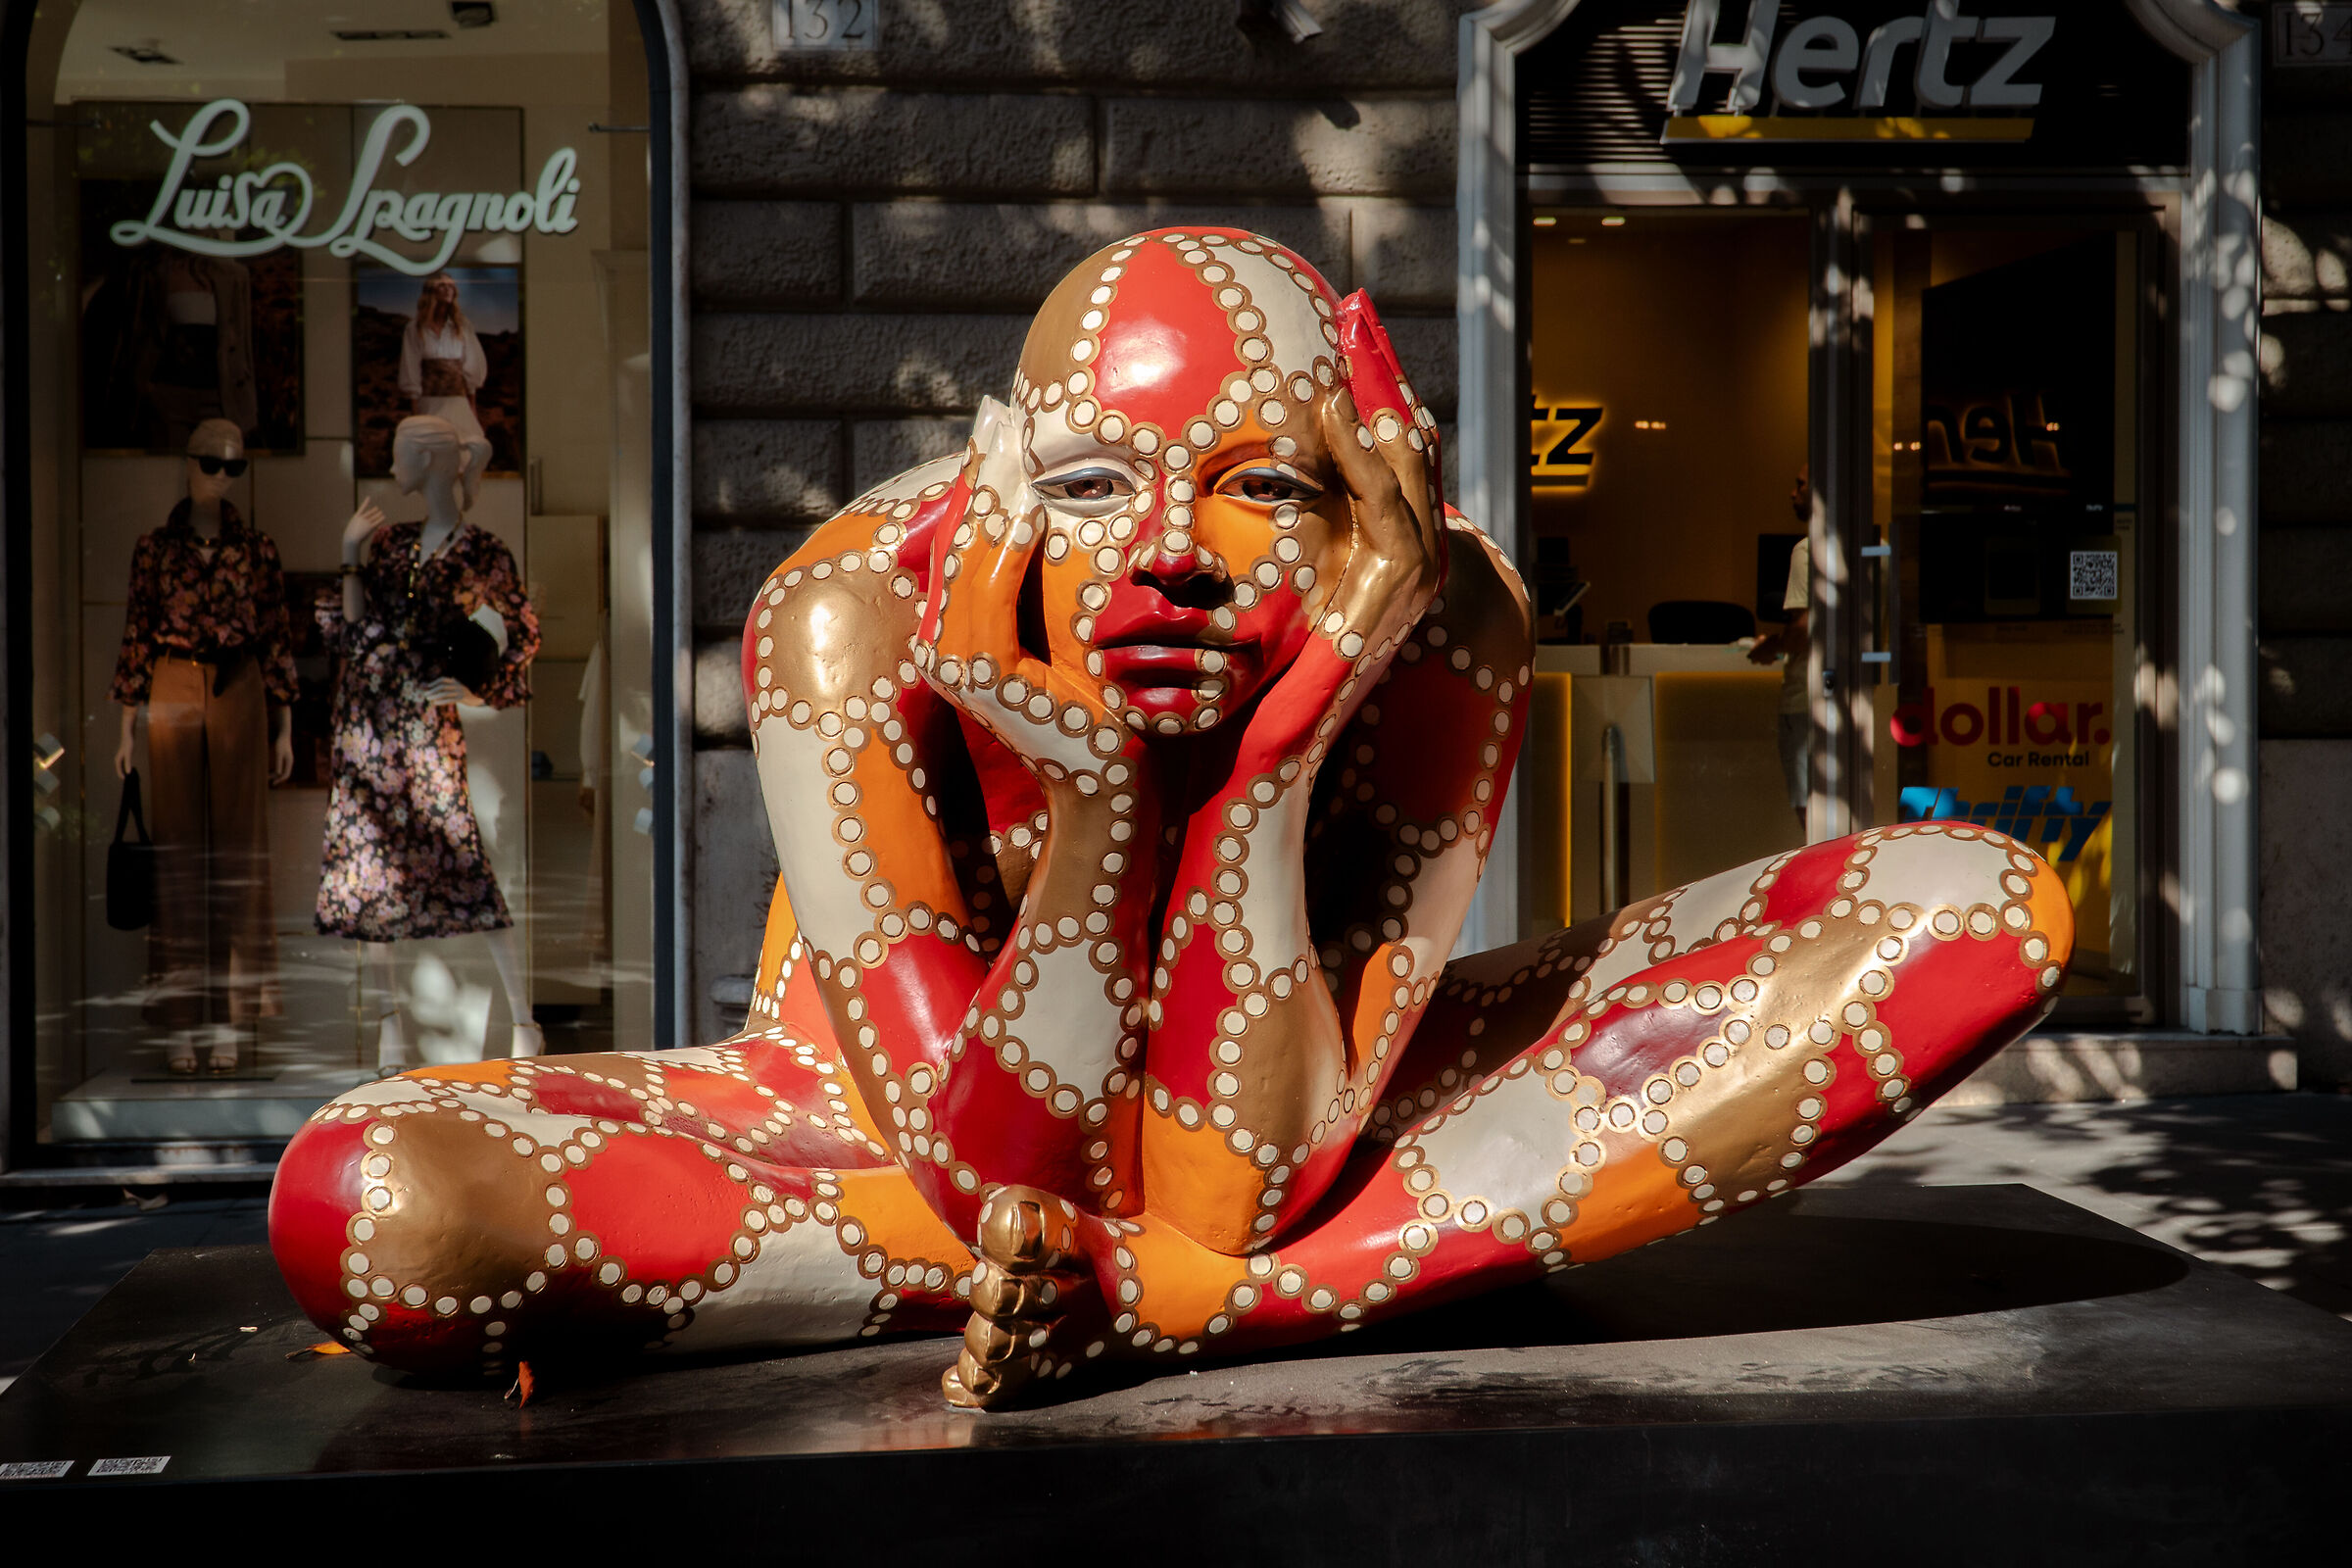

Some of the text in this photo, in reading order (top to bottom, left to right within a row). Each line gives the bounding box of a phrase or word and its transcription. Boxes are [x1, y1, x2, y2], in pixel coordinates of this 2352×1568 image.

[787, 0, 866, 39] 132
[1666, 0, 2057, 110] Hertz
[110, 99, 581, 276] Luisa Spagnoli
[1889, 687, 2111, 748] dollar.
[1987, 752, 2089, 767] Car Rental
